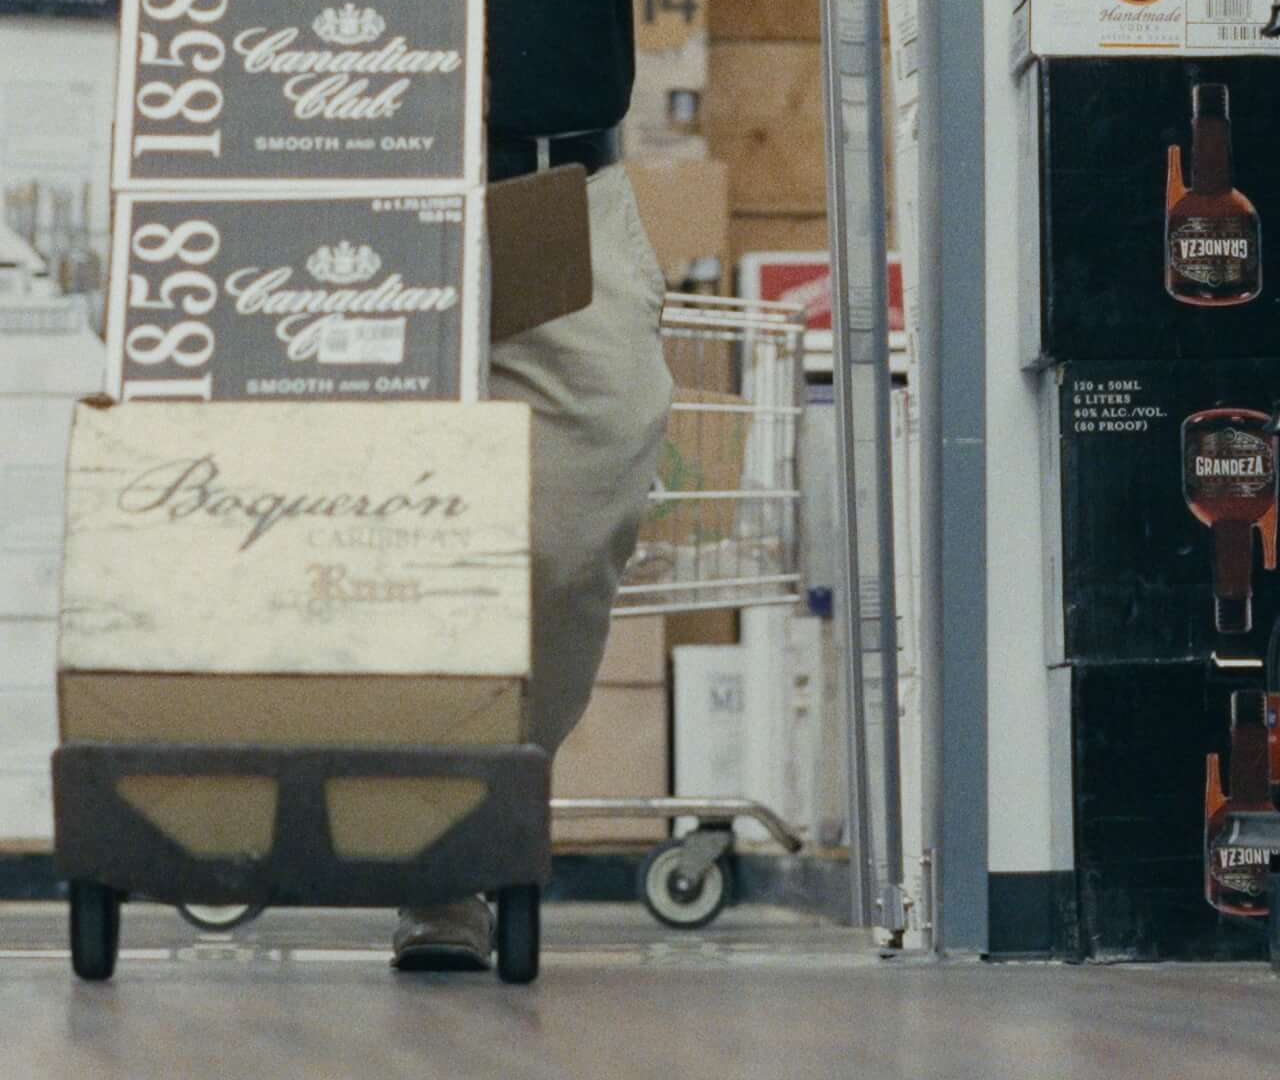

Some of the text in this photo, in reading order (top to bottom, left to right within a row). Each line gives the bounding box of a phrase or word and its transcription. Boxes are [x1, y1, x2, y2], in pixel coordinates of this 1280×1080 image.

[1098, 6, 1182, 23] Handmade
[233, 26, 462, 72] Canadian
[283, 73, 410, 119] Club
[255, 136, 340, 151] SMOOTH
[380, 136, 435, 151] OAKY
[1181, 238, 1248, 259] GRANDEZA
[224, 267, 458, 314] Canadian
[123, 220, 220, 402] 1858
[247, 377, 335, 393] SMOOTH
[374, 376, 430, 392] OAKY
[1074, 381, 1094, 391] 120
[1108, 380, 1142, 391] 50ML
[1073, 394, 1131, 404] 6 LITERS
[1073, 407, 1167, 418] 40% ALC./VOL.
[1098, 420, 1148, 432] PROOF)
[1196, 455, 1263, 477] GRANDEZA
[118, 452, 470, 552] Boquerón
[1220, 847, 1271, 868] ANDEZA
